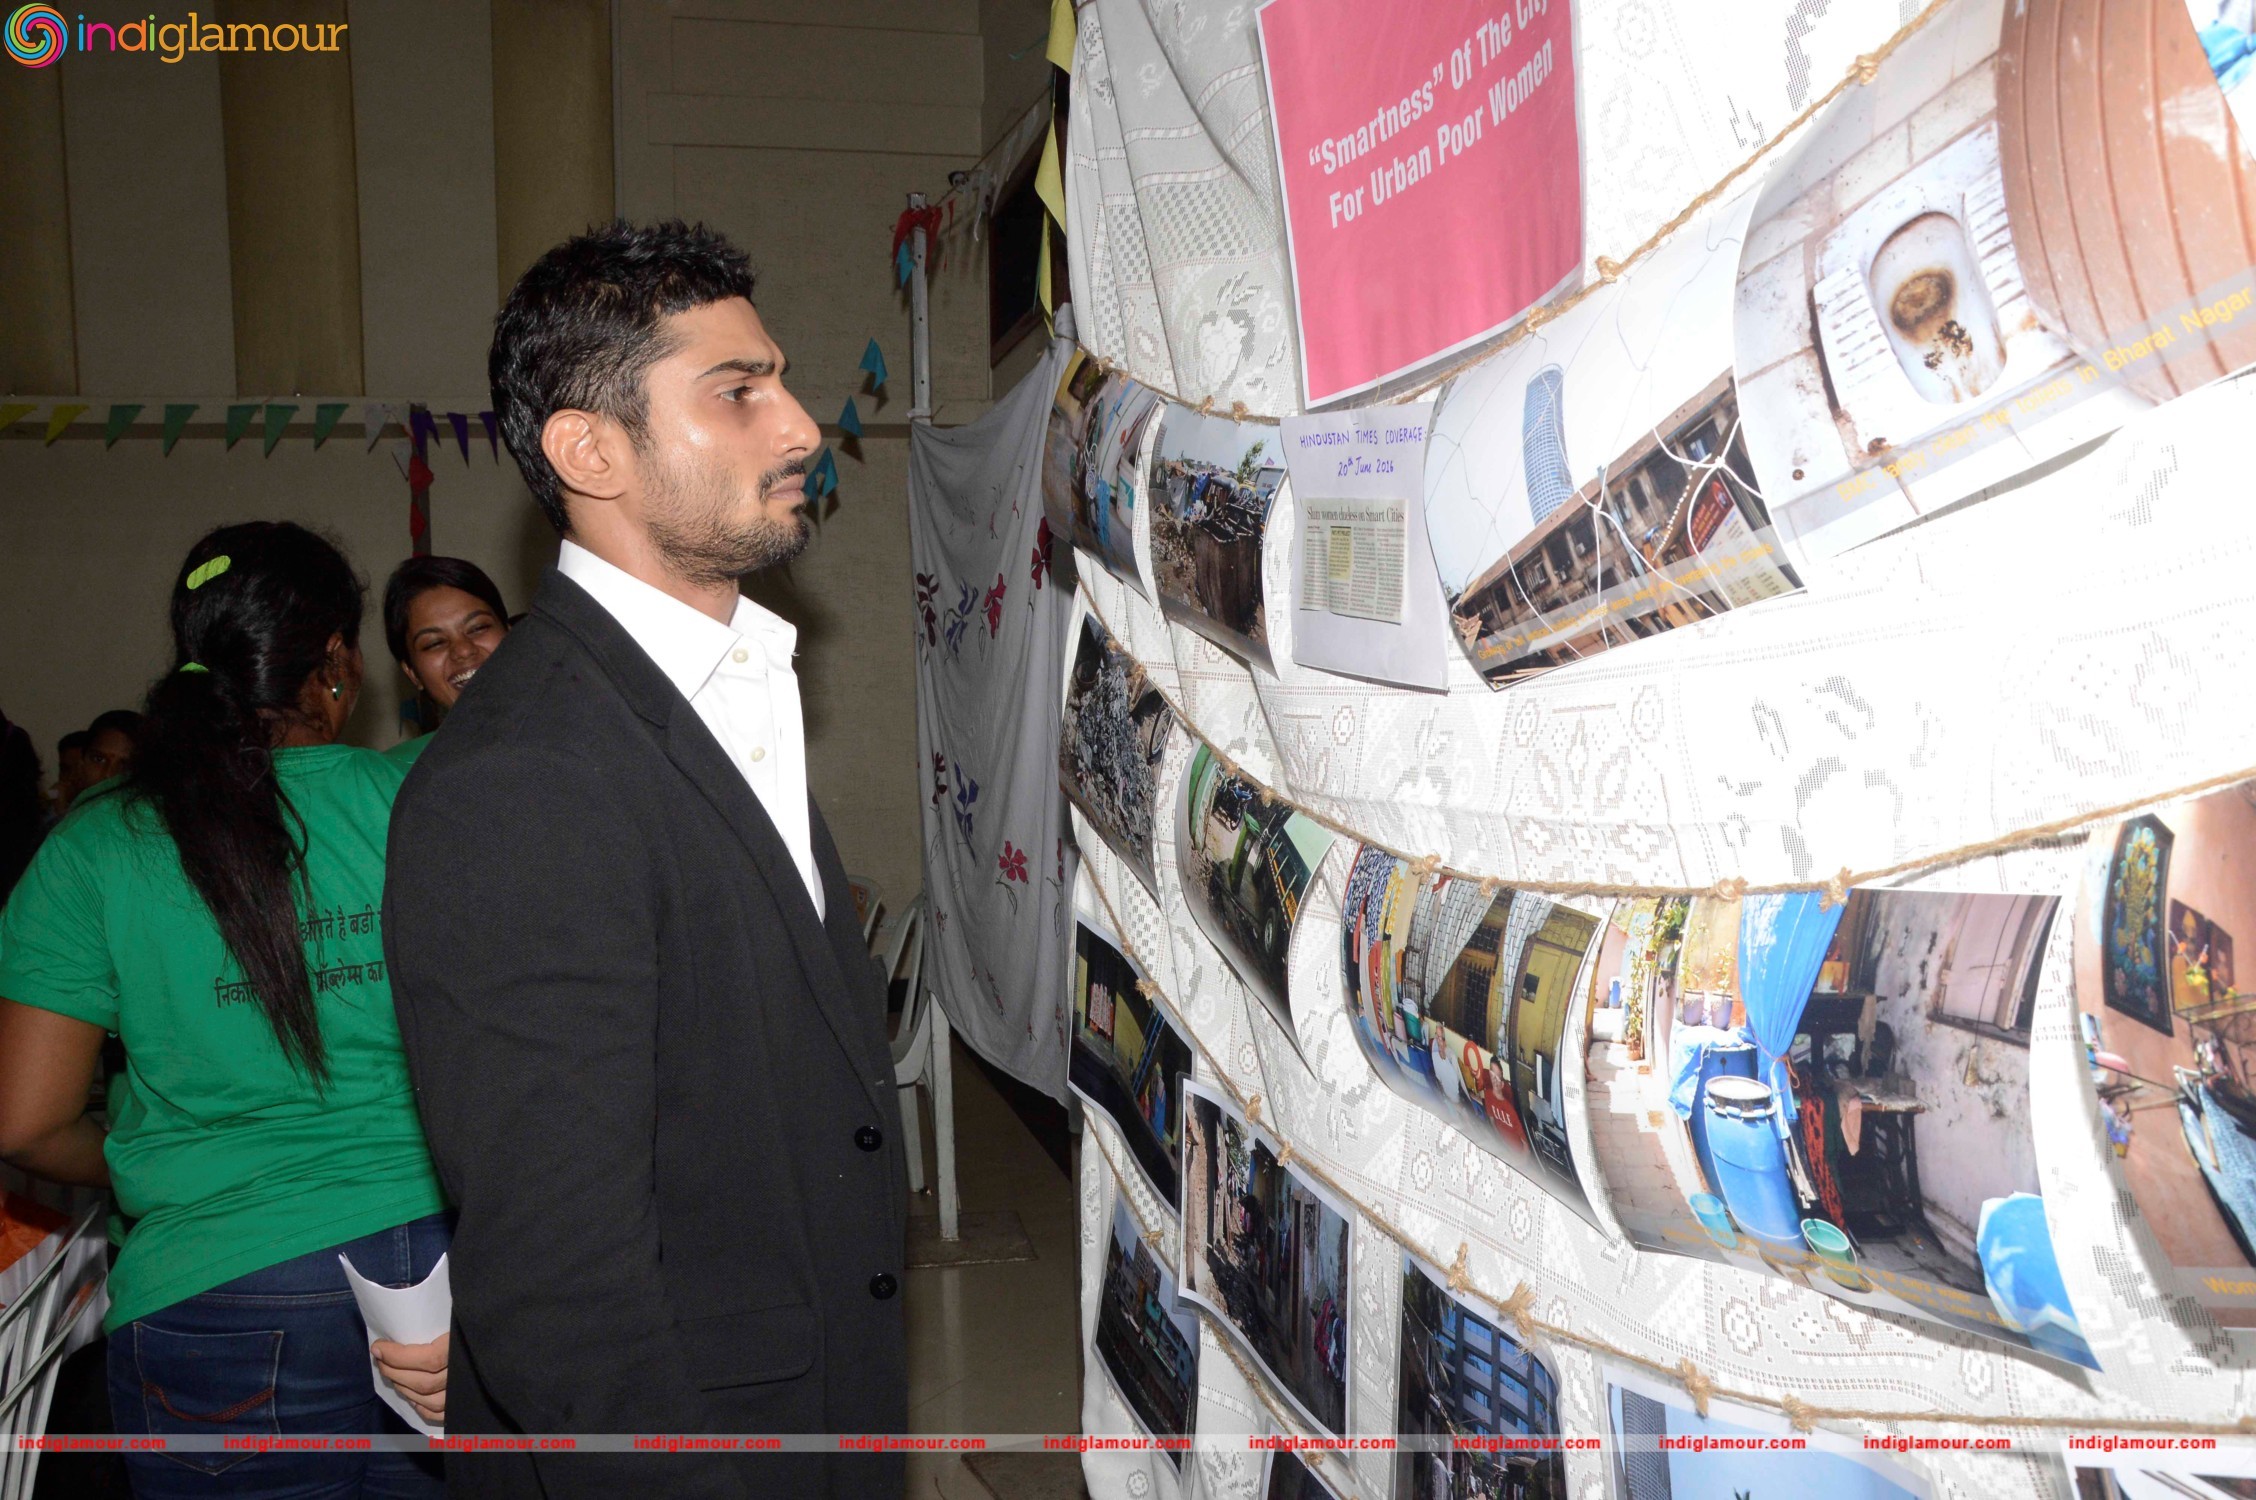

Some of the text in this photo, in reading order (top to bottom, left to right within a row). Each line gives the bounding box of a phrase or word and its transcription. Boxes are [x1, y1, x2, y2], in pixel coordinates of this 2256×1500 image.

[1309, 62, 1443, 174] “Smartness”
[1450, 38, 1472, 90] Of
[1476, 12, 1512, 67] The
[1329, 38, 1553, 229] For Urban Poor Women
[1882, 450, 1927, 480] rarely
[1932, 425, 1979, 456] clean
[1980, 408, 2011, 431] the
[2015, 377, 2073, 414] toilets
[2075, 364, 2099, 385] in
[2102, 324, 2176, 371] Bharat
[2179, 287, 2252, 334] Nagar
[1300, 429, 1350, 448] HINDUSTAN
[1355, 430, 1378, 445] TIMES
[1355, 456, 1372, 476] June
[1376, 458, 1394, 474] 2016
[1366, 506, 1385, 522] Smart
[1386, 507, 1404, 523] Cities
[214, 976, 257, 1008] निका
